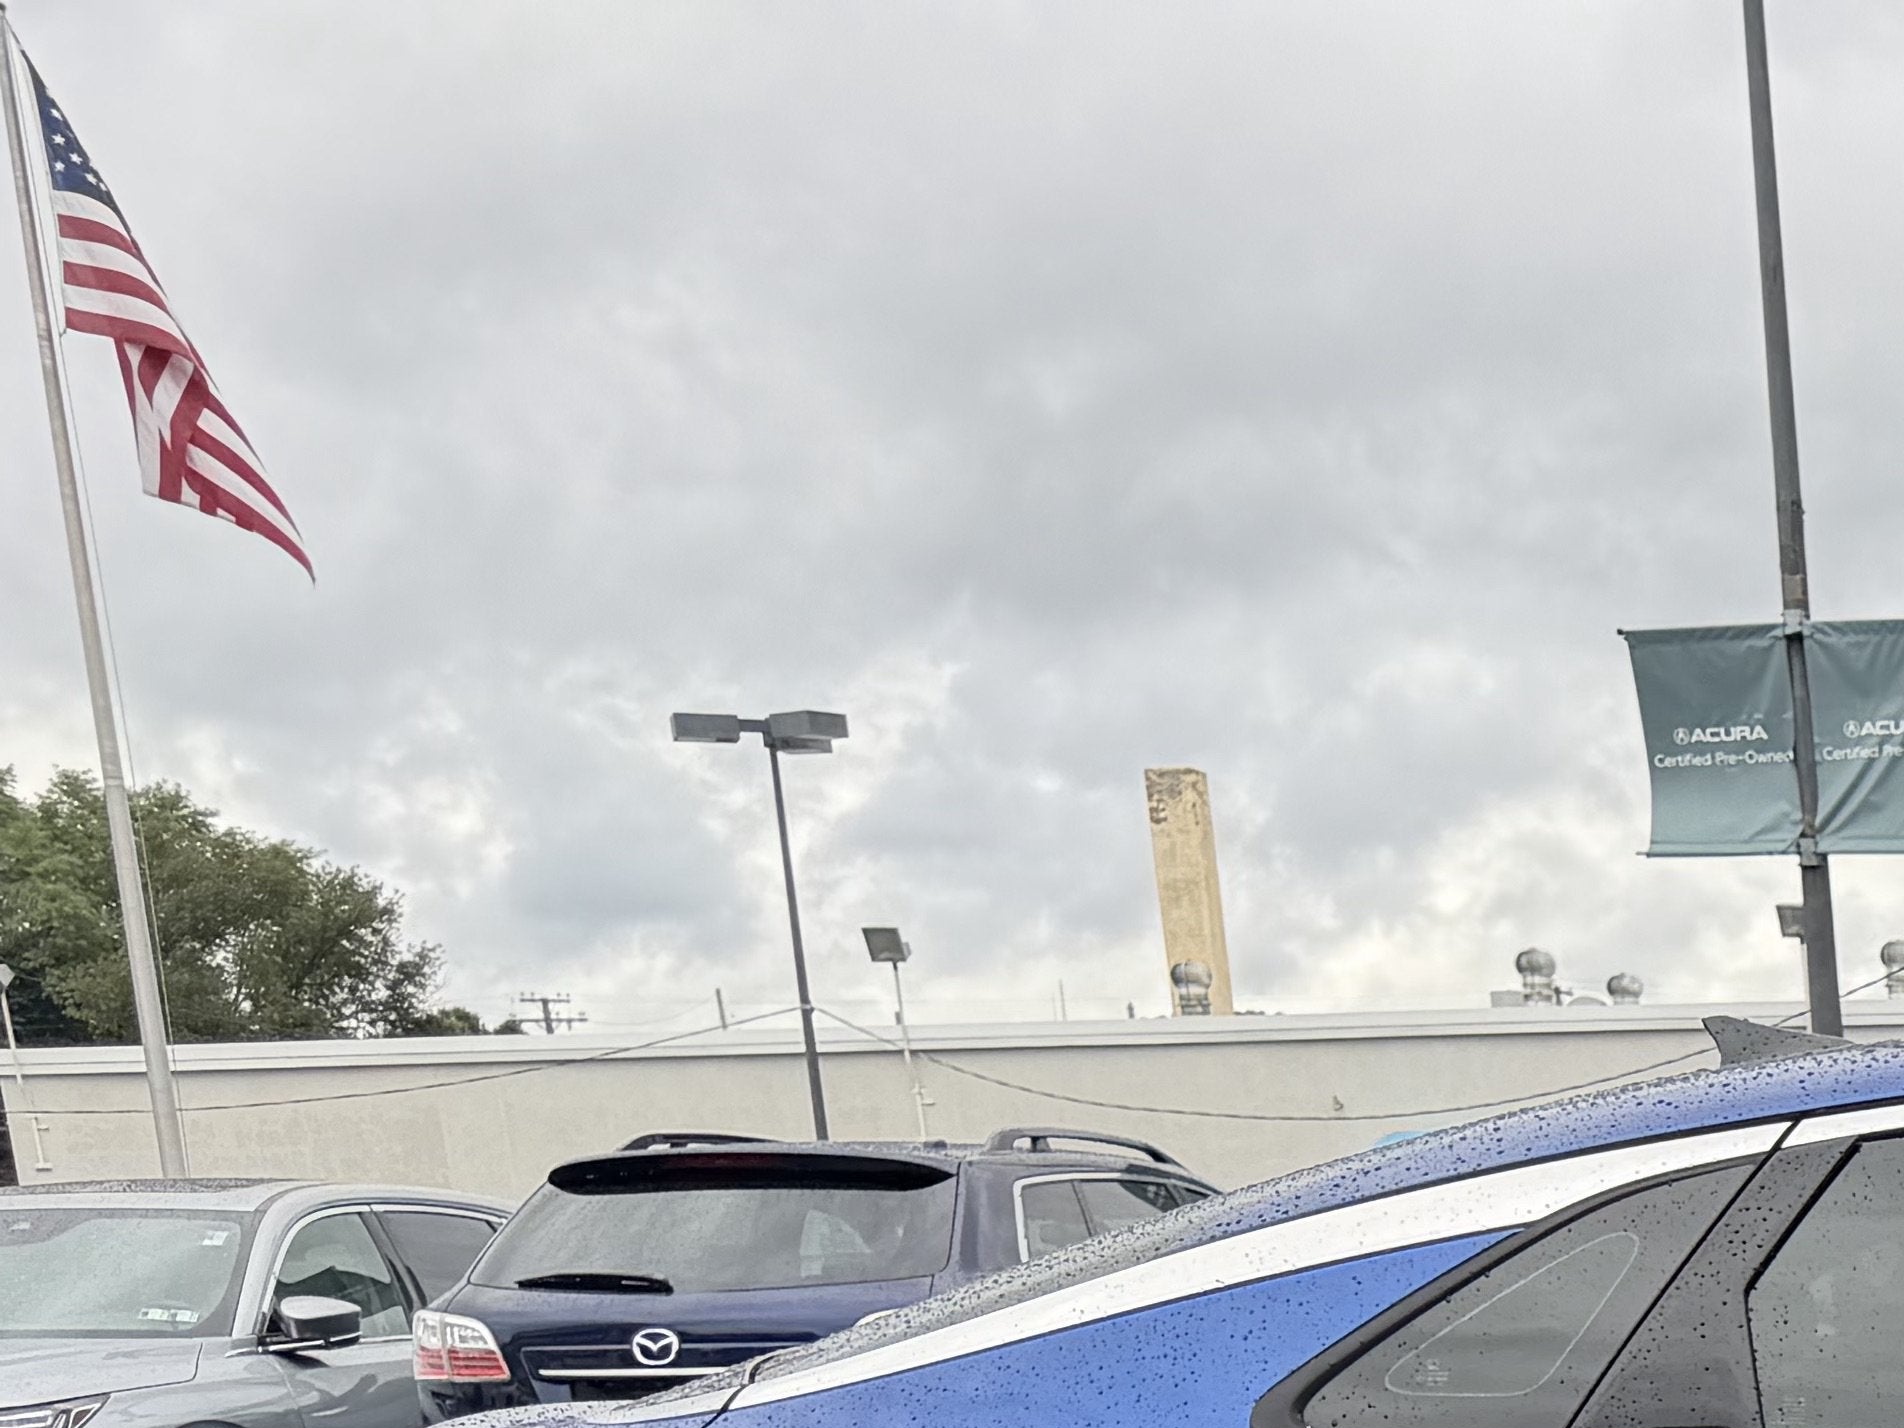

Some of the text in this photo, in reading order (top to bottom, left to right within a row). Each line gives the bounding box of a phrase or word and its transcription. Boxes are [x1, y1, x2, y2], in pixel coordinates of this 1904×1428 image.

[1690, 725, 1769, 743] ACURA
[1654, 749, 1794, 768] Certified Pre-Owned
[1822, 746, 1879, 761] Certified
